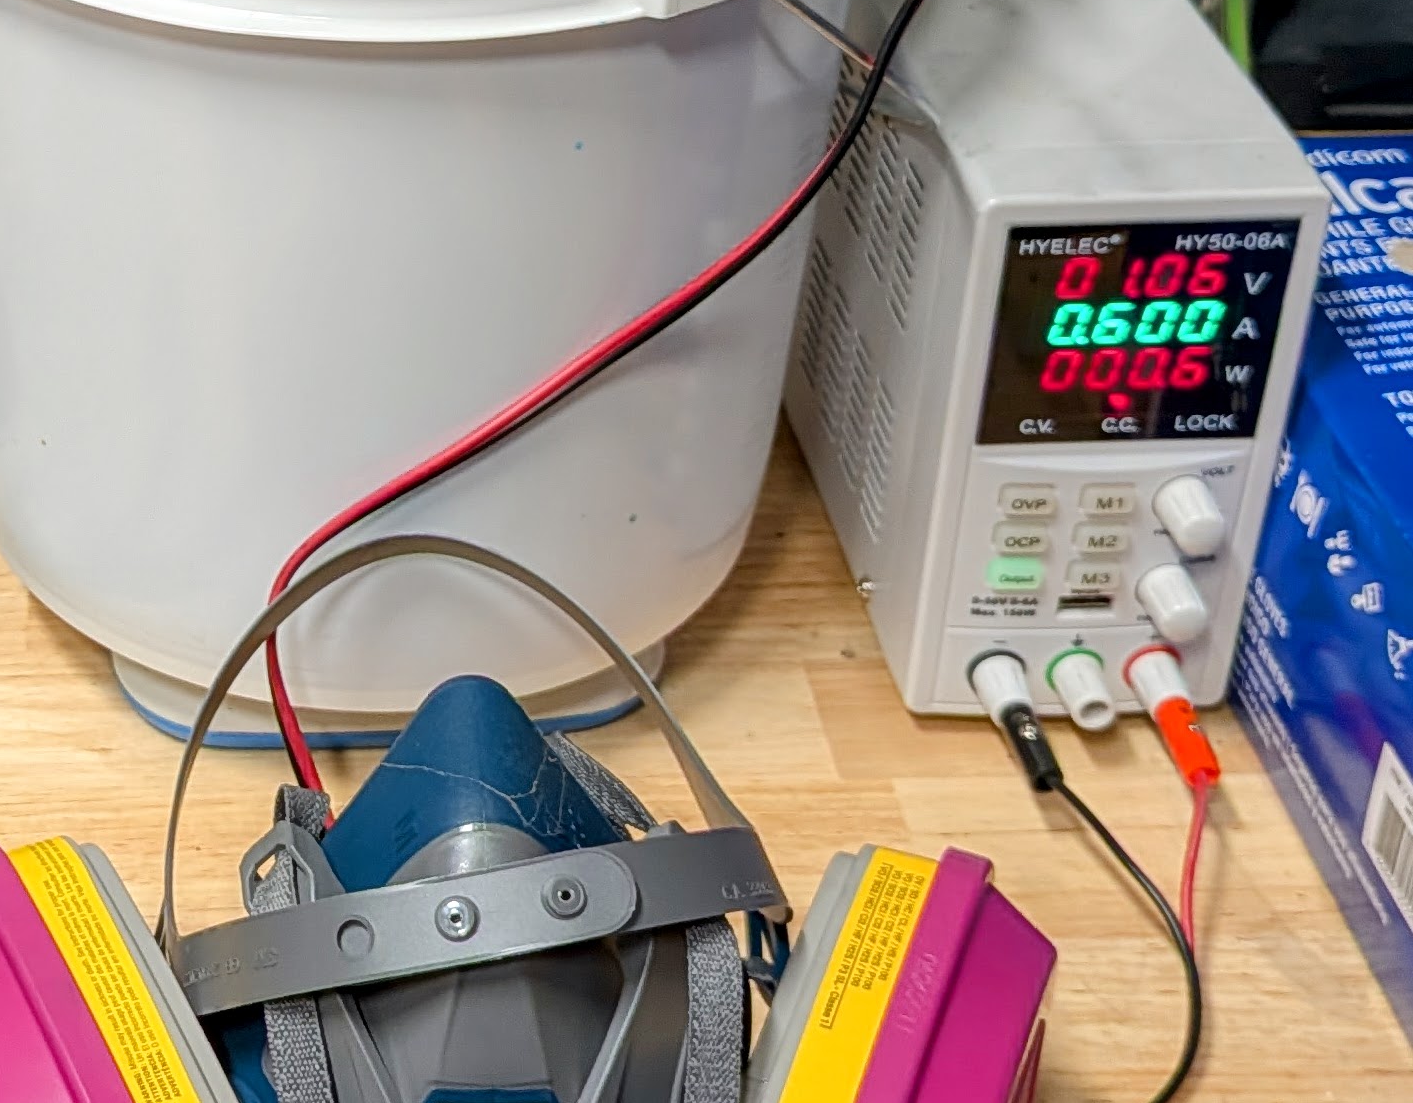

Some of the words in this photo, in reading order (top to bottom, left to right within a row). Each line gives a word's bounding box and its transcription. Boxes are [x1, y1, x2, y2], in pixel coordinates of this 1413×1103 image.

[1019, 236, 1113, 255] HYELEC
[1175, 233, 1288, 251] HY50-06A
[1243, 272, 1273, 295] V
[1313, 283, 1413, 306] GENERAL
[1046, 300, 1228, 346] 0.600
[1232, 317, 1261, 340] A
[1225, 364, 1254, 384] W
[1174, 414, 1237, 432] LOCK
[1011, 498, 1047, 510] OVP
[1096, 497, 1124, 509] M1
[1004, 536, 1040, 547] OCP
[1088, 535, 1117, 547] M2
[1081, 572, 1110, 584] M3
